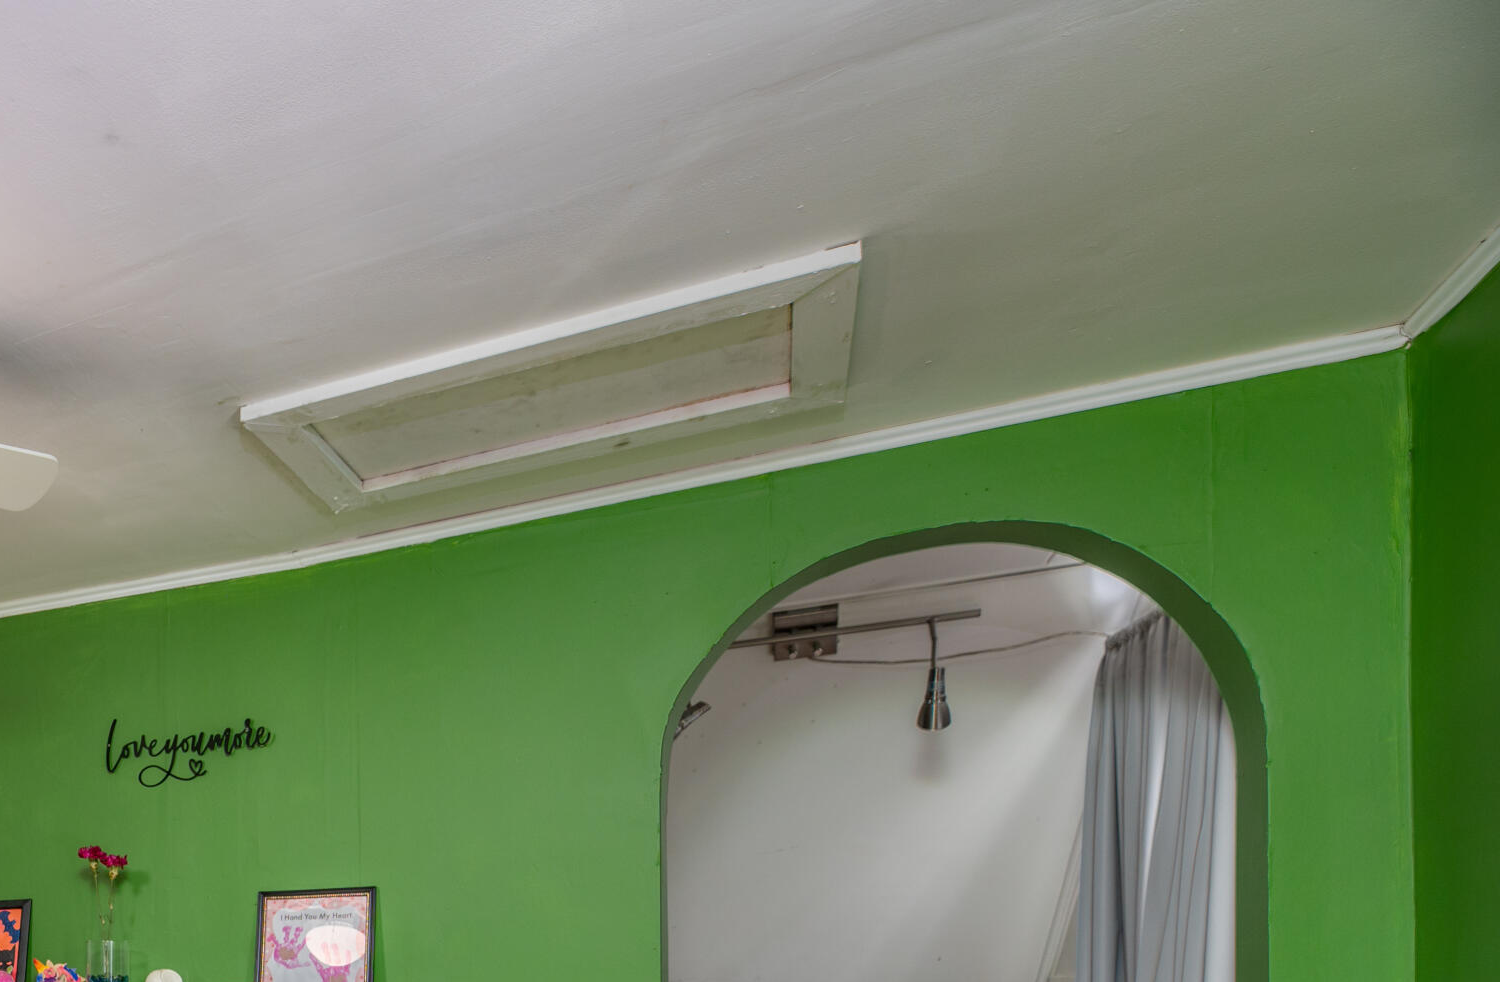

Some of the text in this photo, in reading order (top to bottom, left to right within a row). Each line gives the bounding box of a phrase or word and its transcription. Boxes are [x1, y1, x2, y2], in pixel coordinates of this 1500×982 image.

[304, 912, 317, 920] You
[319, 911, 330, 920] My
[332, 911, 352, 919] Heart
